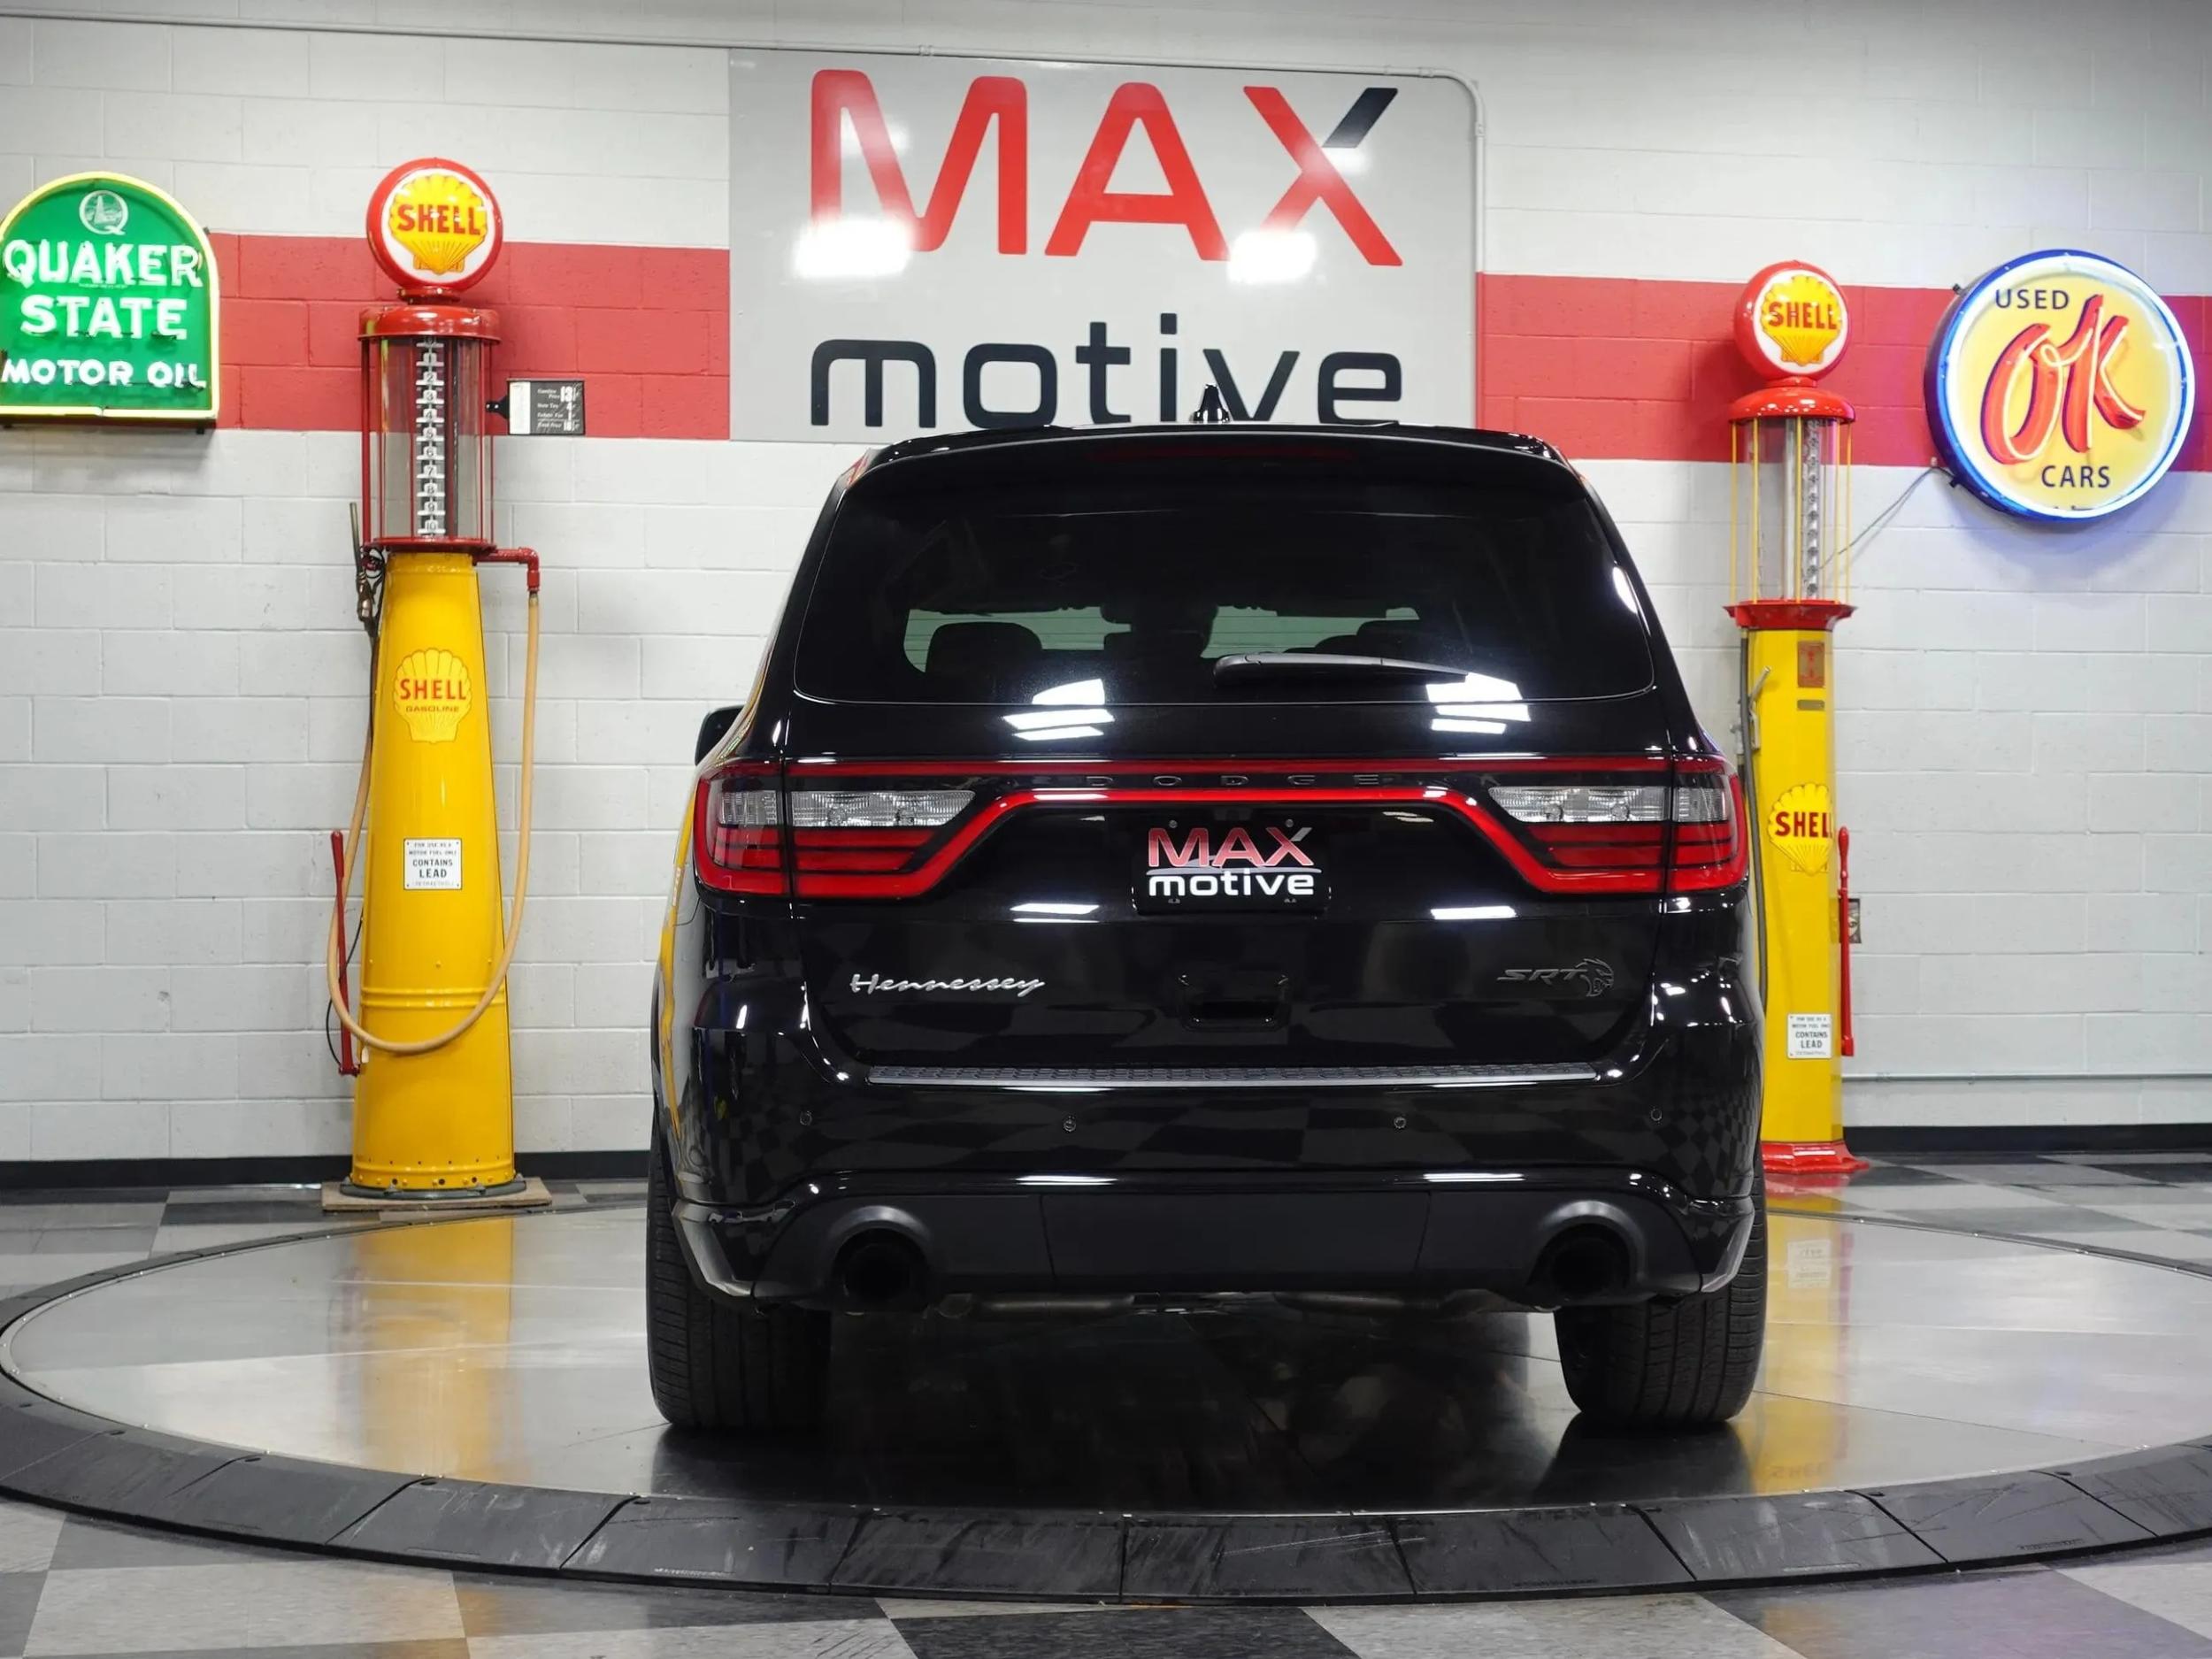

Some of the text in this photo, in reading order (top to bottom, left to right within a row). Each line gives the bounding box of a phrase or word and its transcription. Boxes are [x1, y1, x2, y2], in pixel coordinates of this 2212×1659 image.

[810, 69, 1403, 266] MAX
[396, 204, 481, 236] SHELL
[3, 239, 204, 288] QUAKER
[1995, 288, 2070, 310] USED
[20, 295, 188, 341] STATE
[1768, 301, 1838, 330] SHELL
[1, 358, 206, 388] MOTOR OIL
[810, 313, 1402, 429] motive
[1980, 294, 2147, 465] OK
[2041, 465, 2111, 488] CARS
[399, 678, 467, 701] SHELL
[1086, 774, 1379, 787] DODGE
[1148, 826, 1315, 867] MAX
[412, 858, 454, 867] CONTAINS
[419, 868, 448, 879] LEAD
[1148, 867, 1315, 897] motive
[850, 973, 1046, 997] Hennessey
[1497, 969, 1588, 985] SRT
[1801, 1040, 1824, 1048] LEAD
